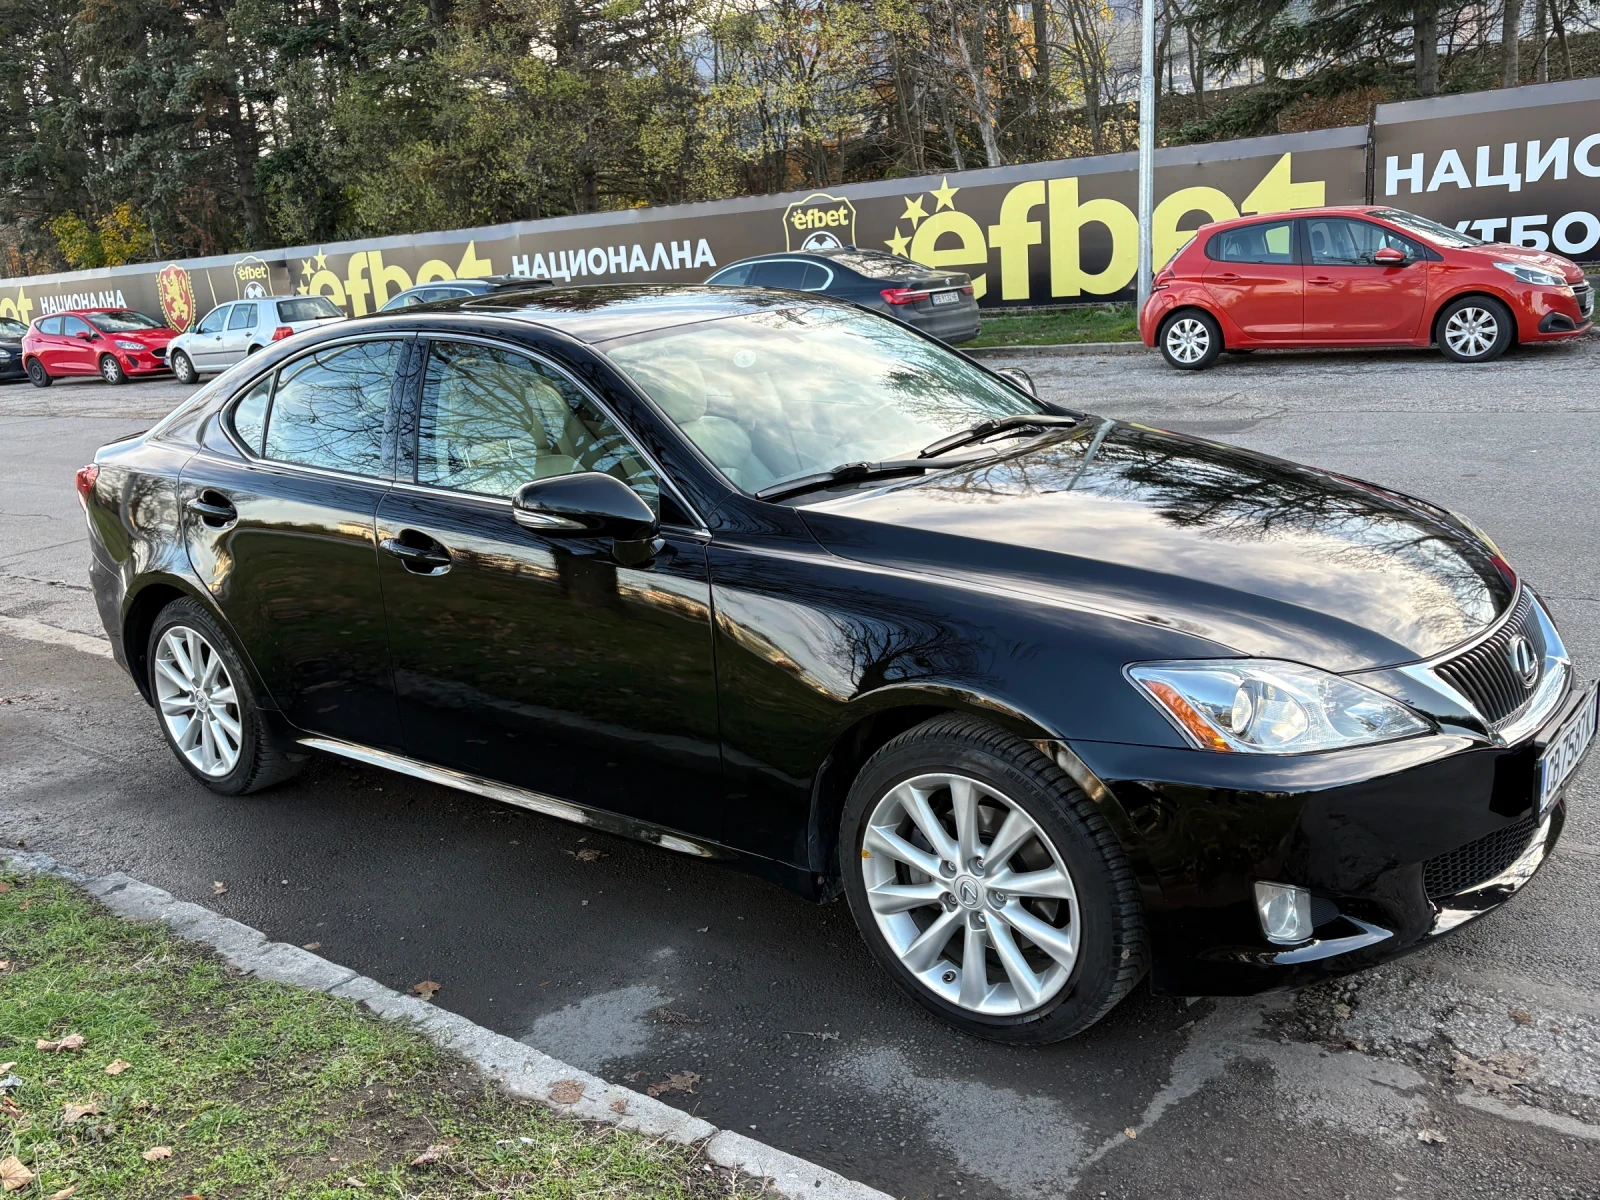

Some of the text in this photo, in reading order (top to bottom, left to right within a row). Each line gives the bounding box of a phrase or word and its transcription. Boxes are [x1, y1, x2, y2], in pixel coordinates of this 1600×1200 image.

[793, 205, 849, 230] efbet
[1454, 211, 1600, 255] ТБО
[238, 265, 267, 281] efbet
[511, 238, 717, 282] НАЦИОНАЛНА
[39, 289, 127, 315] НАЦИОНАЛНА
